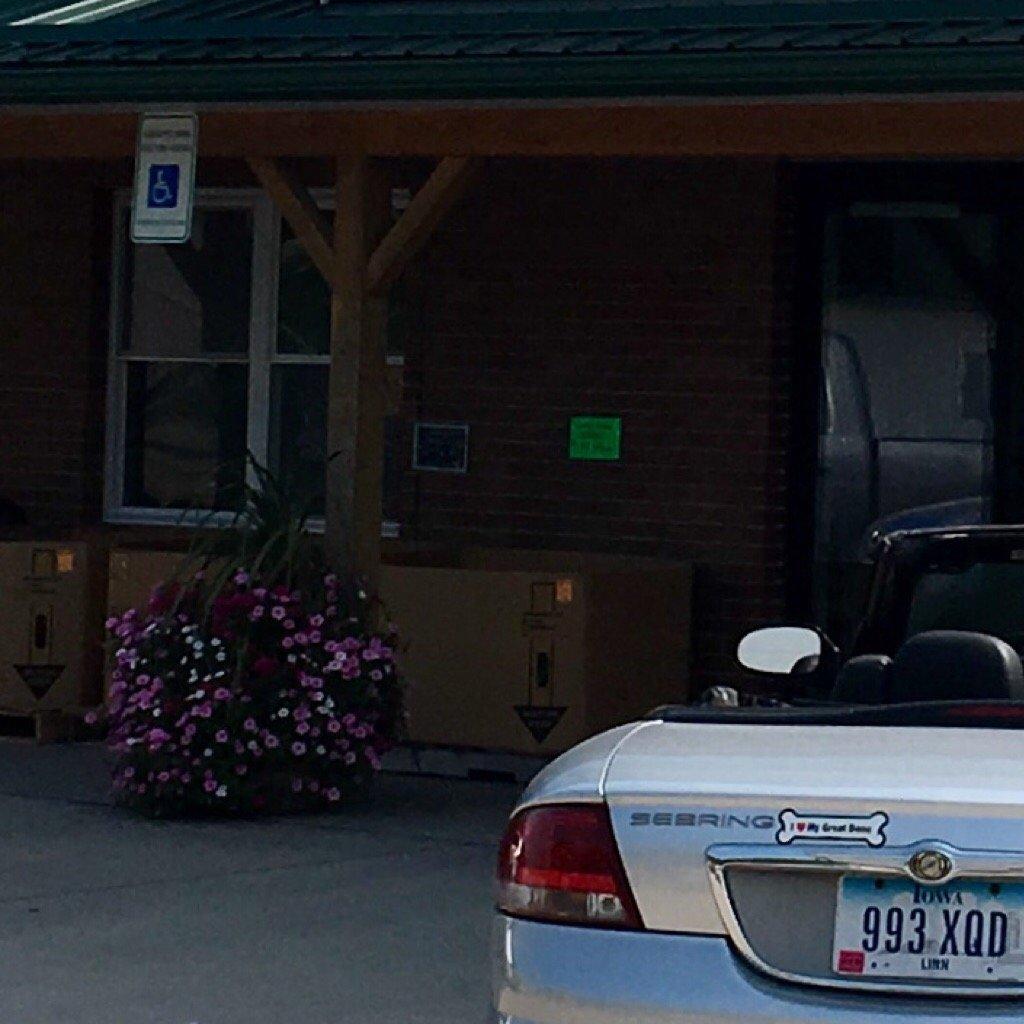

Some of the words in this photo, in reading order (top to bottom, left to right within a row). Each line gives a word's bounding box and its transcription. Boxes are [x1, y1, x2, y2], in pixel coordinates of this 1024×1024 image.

[630, 812, 774, 829] SEBRING
[862, 906, 926, 954] 993
[939, 909, 1008, 957] XQD
